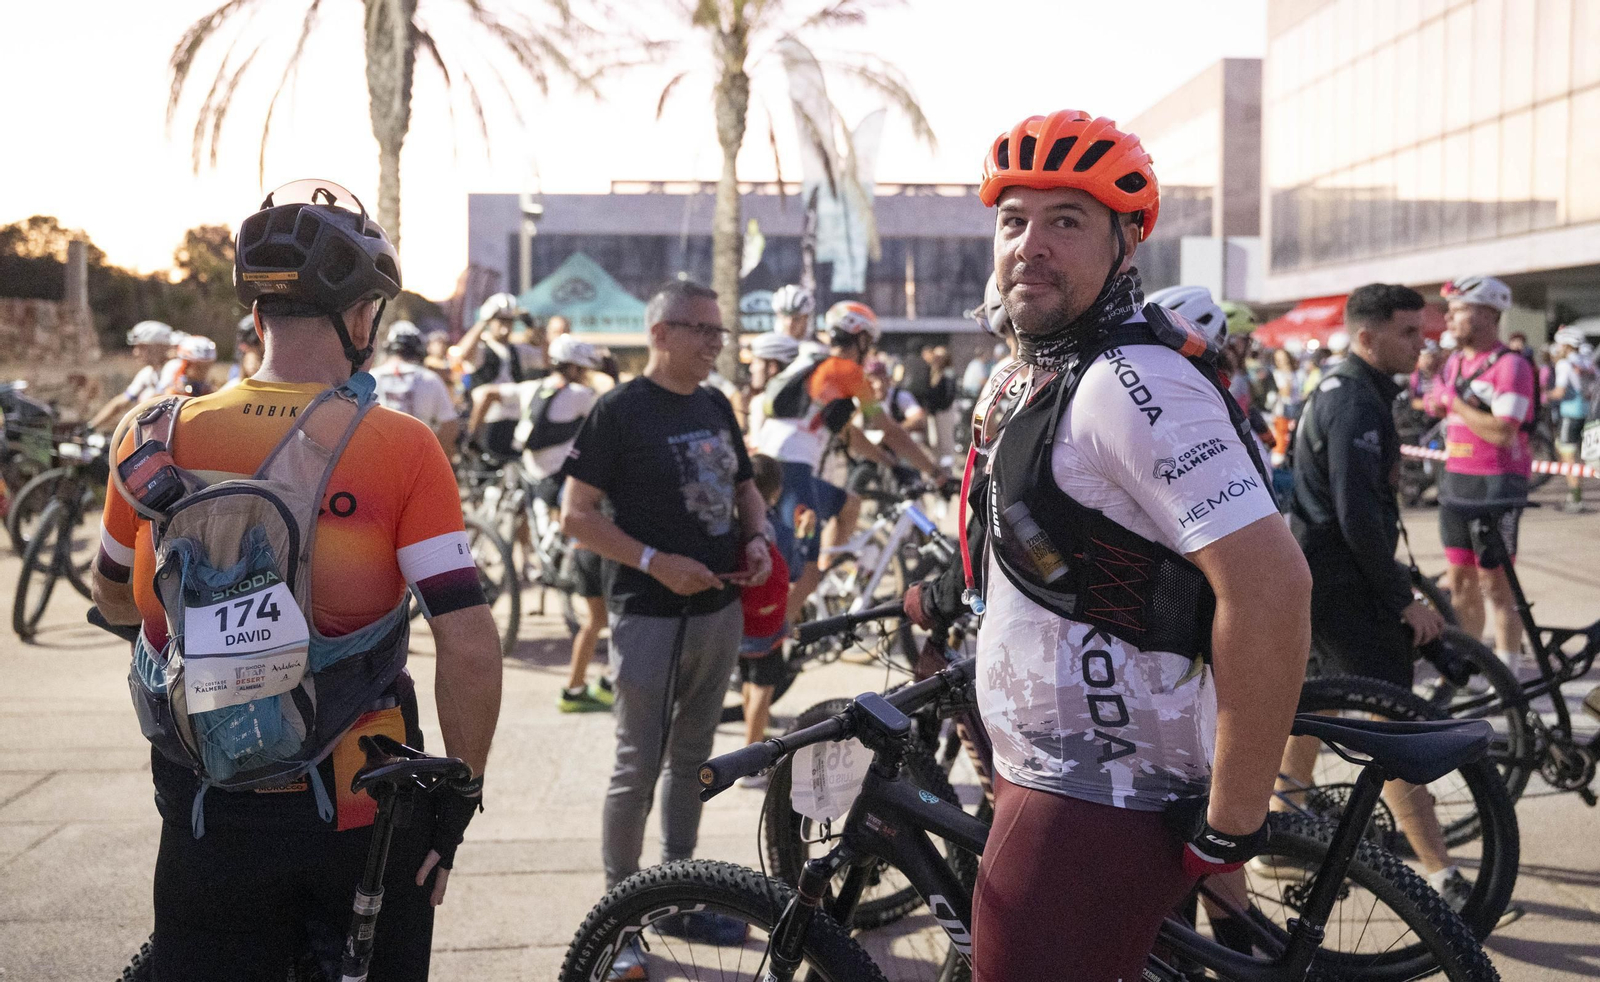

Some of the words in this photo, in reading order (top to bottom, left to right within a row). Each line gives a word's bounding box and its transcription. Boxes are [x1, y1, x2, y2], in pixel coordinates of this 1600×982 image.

[1107, 304, 1133, 320] unicef
[243, 403, 299, 417] GOBIK
[1178, 442, 1208, 462] COSTA
[1209, 437, 1222, 446] DE
[1177, 443, 1229, 477] ALMERÍA
[214, 592, 281, 632] 174
[225, 628, 271, 646] DAVID
[201, 684, 228, 693] ALMERÍA
[236, 675, 266, 685] DESERT
[574, 944, 595, 972] FAST
[591, 916, 618, 941] TRAK
